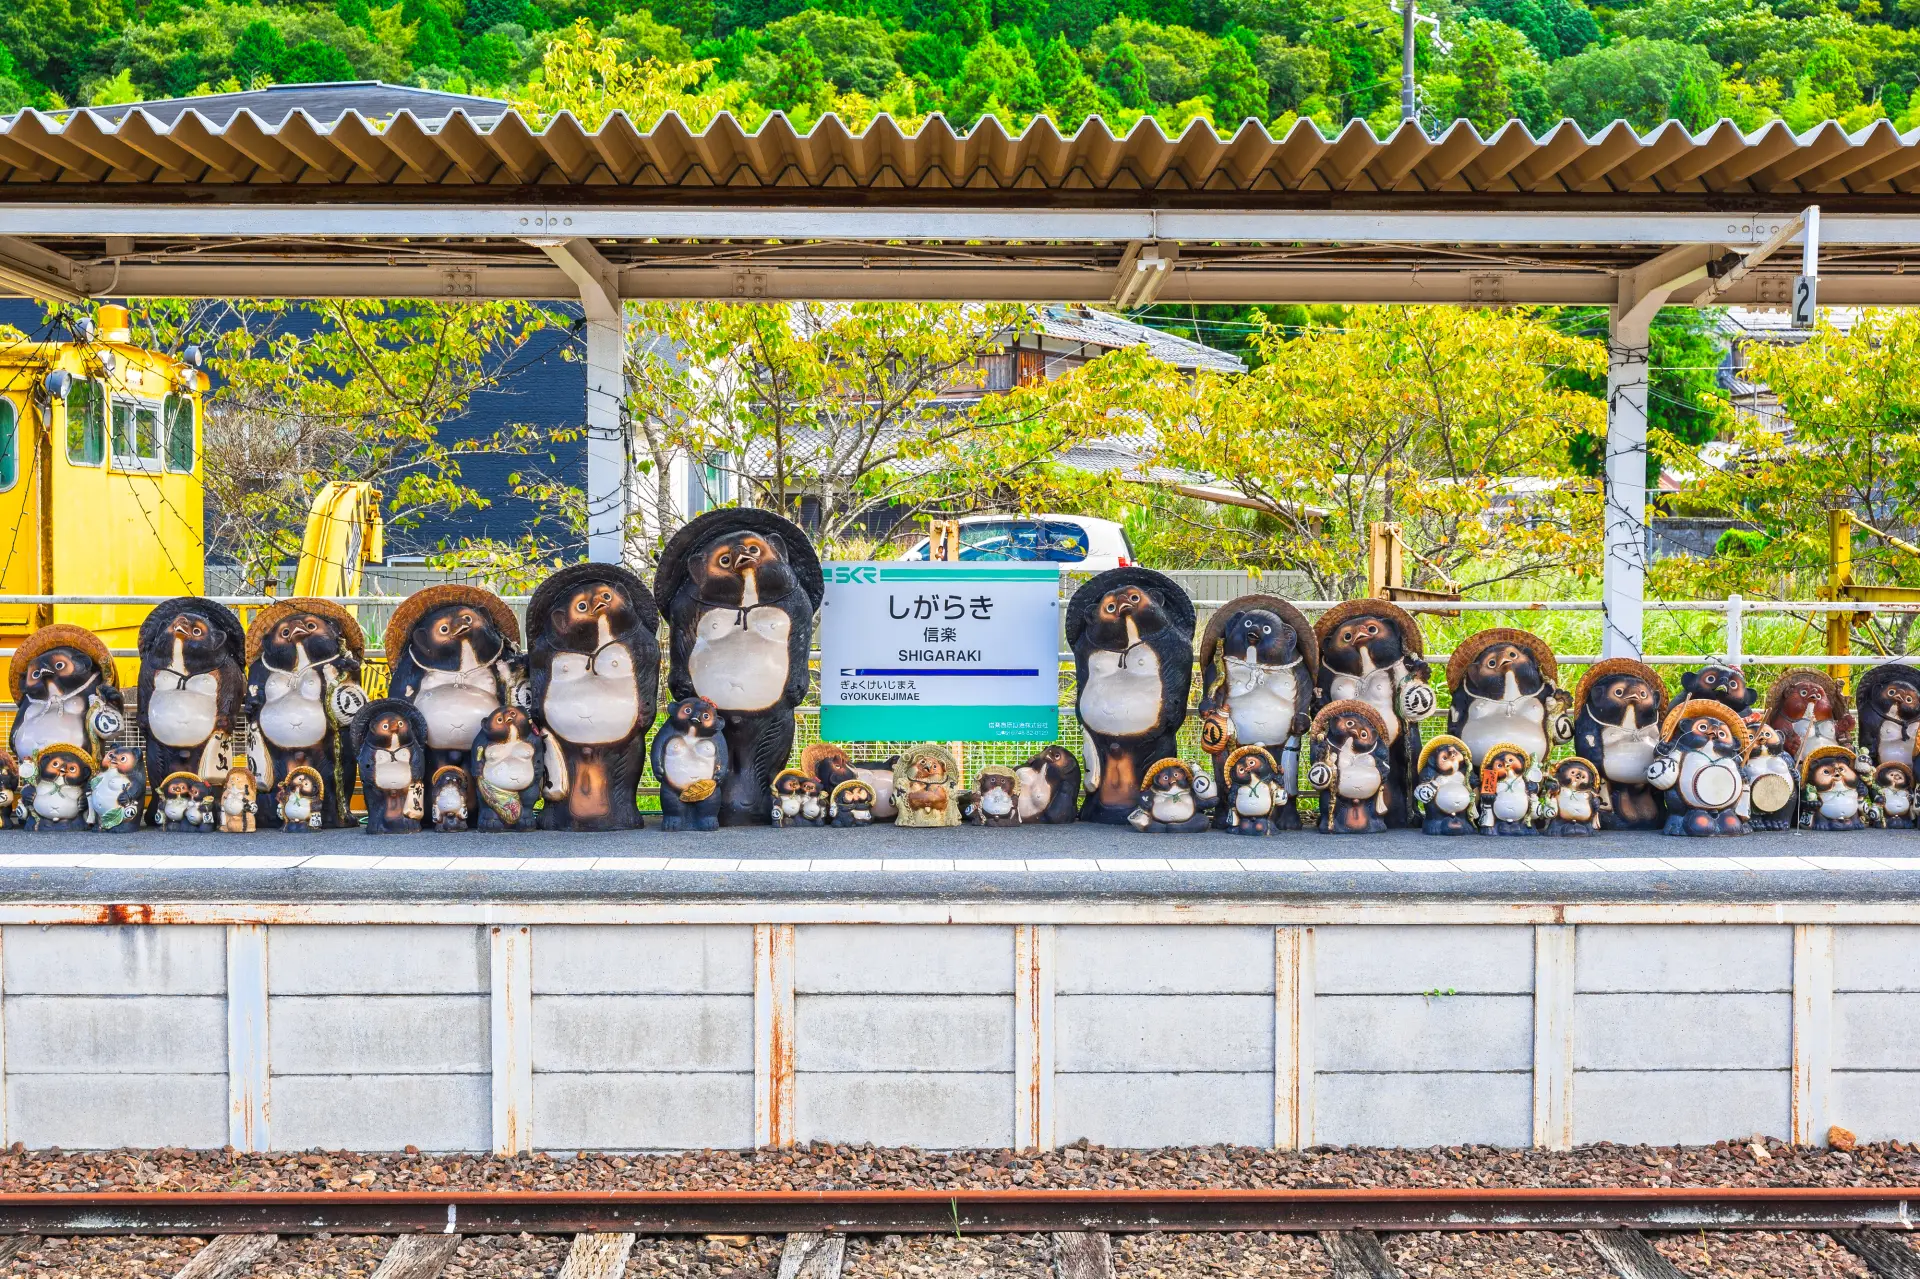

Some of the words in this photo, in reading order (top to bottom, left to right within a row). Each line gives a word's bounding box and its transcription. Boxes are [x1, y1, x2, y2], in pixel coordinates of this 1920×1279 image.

[1796, 283, 1809, 322] 2
[835, 566, 879, 584] SKR
[889, 594, 994, 620] しがらき
[923, 627, 957, 643] 信楽
[898, 649, 981, 662] SHIGARAKI
[840, 679, 917, 690] ぎょくけいじまえ
[840, 692, 920, 701] GYOKUKEIJIMAE
